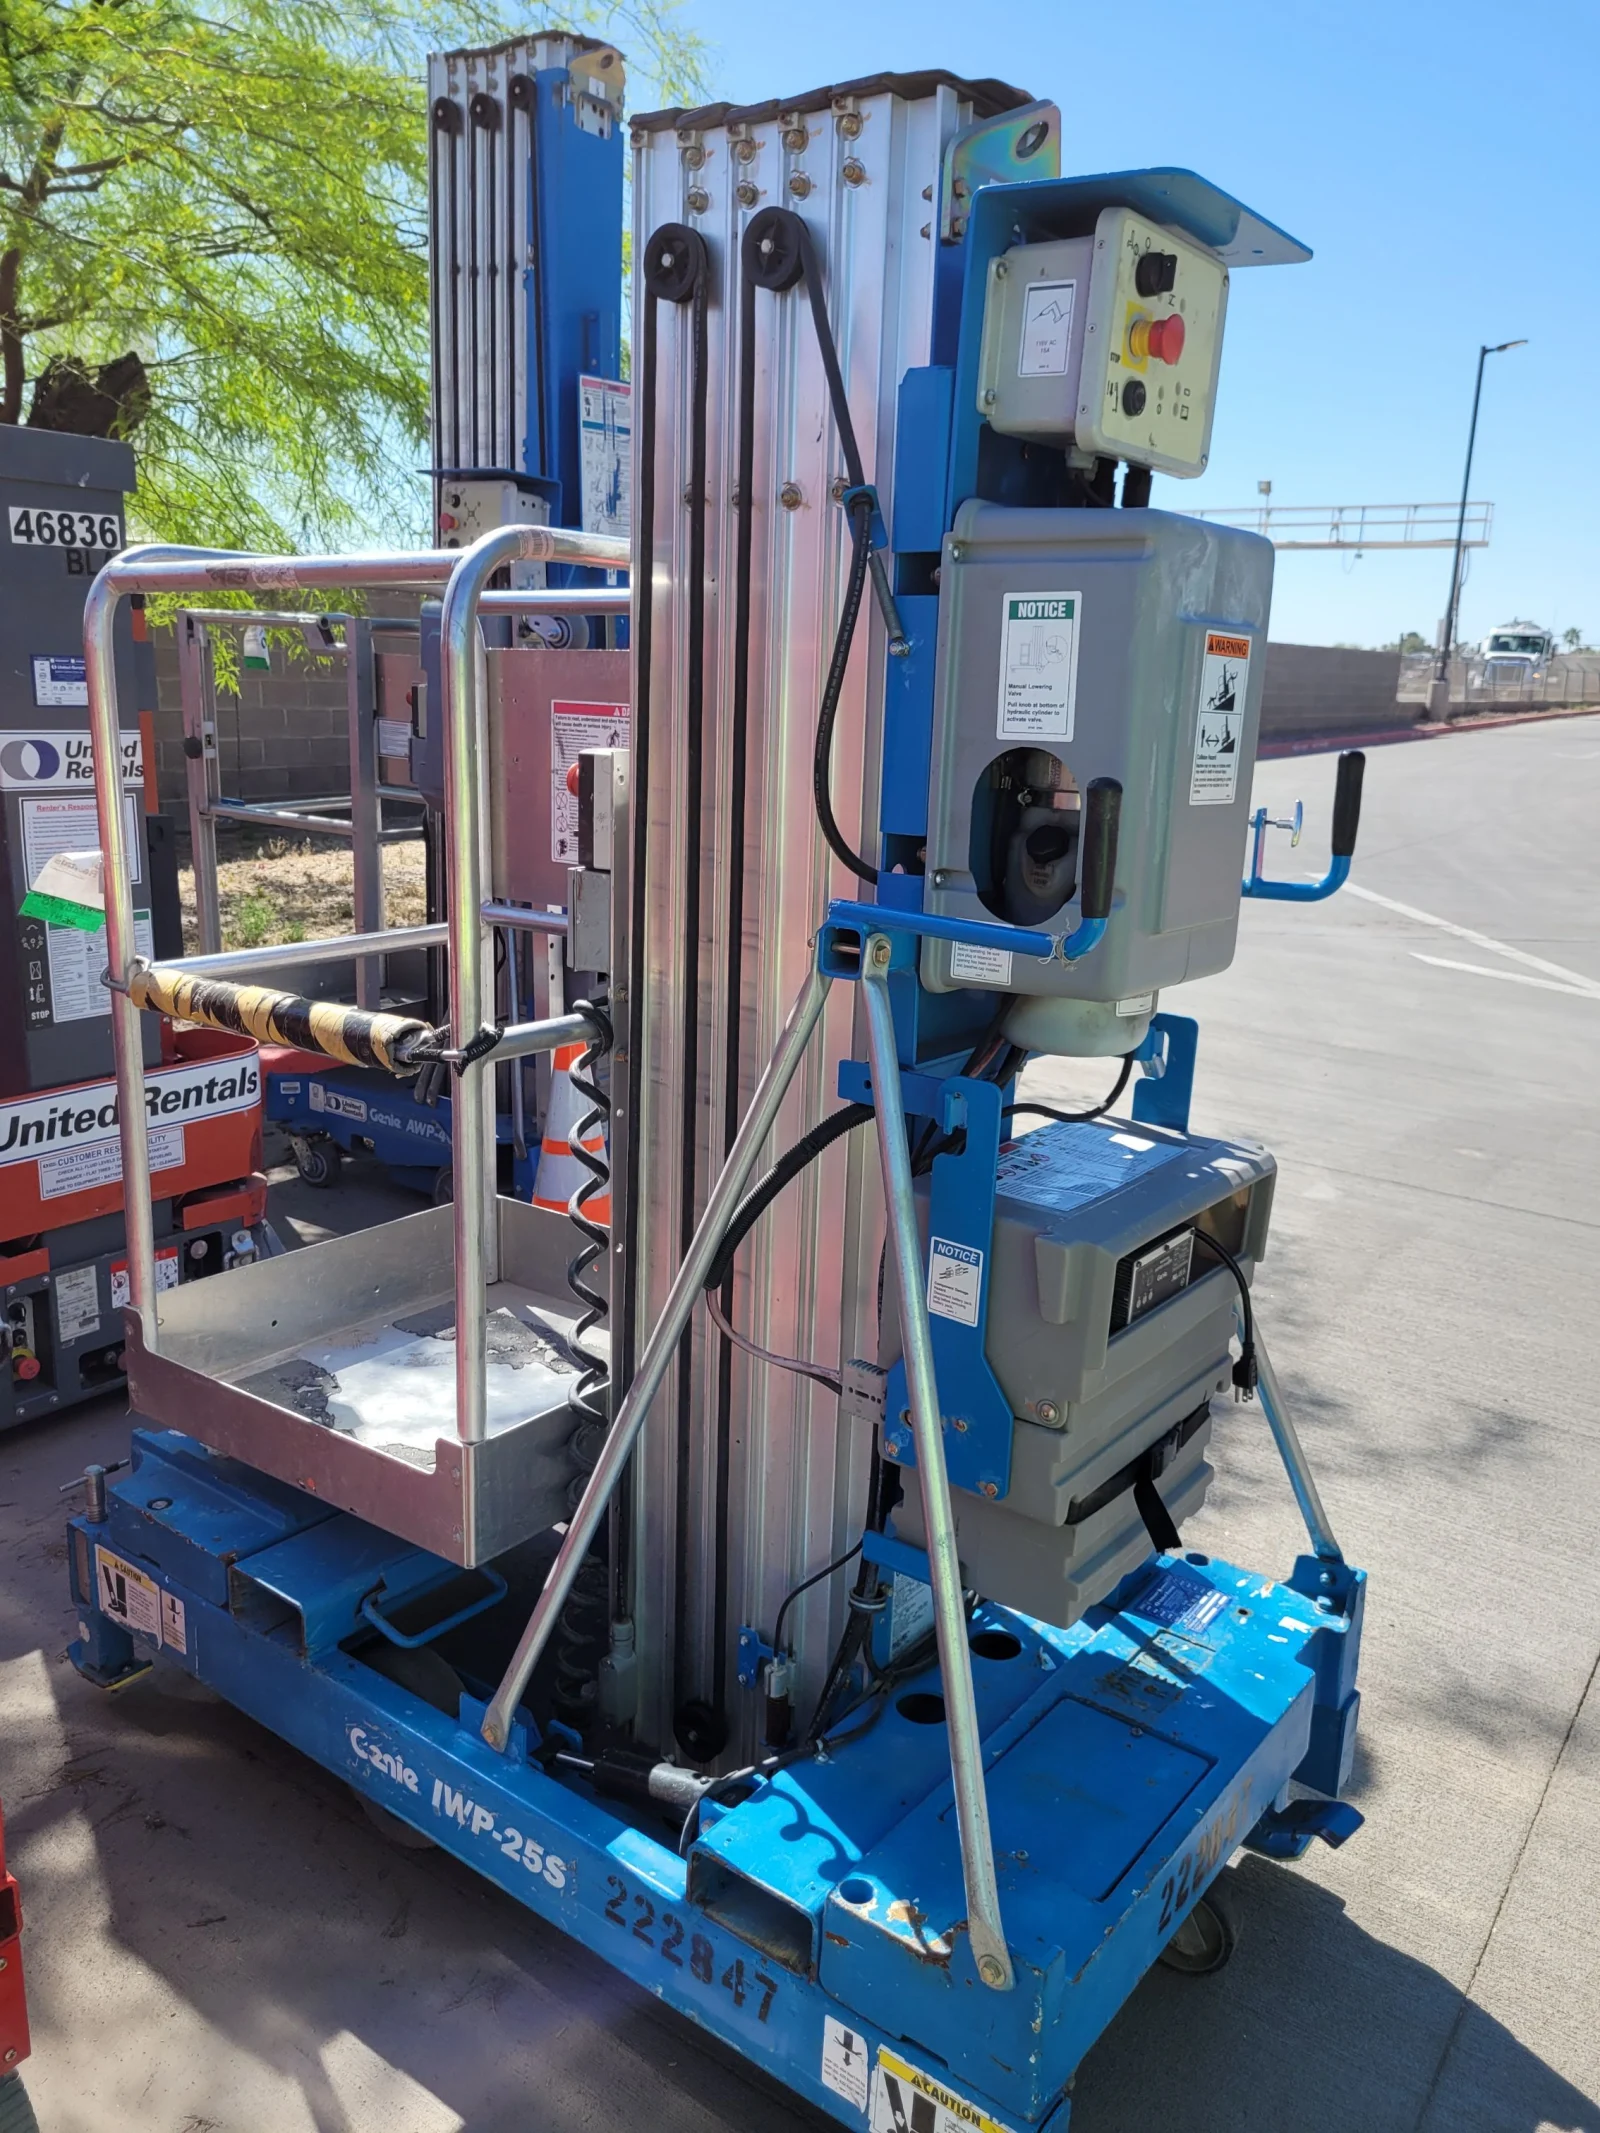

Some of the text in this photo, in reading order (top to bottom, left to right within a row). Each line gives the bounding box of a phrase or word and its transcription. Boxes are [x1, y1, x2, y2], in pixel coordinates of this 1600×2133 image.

[14, 509, 118, 549] 46836
[1017, 601, 1067, 618] NOTICE
[1214, 640, 1248, 657] WARNING
[1028, 683, 1053, 691] Lowering
[65, 740, 138, 759] Und
[30, 1010, 50, 1020] STOP
[144, 1066, 258, 1117] Rentals
[341, 1099, 363, 1111] United
[341, 1107, 364, 1119] Rentals
[369, 1108, 403, 1129] Genie
[57, 1149, 102, 1167] CUSTOMER
[937, 1243, 978, 1264] NOTICE
[119, 1562, 142, 1583] CAUTION
[431, 1778, 568, 1889] IWP-25S
[604, 1874, 778, 2024] 222847
[923, 2080, 982, 2128] CAUTION
